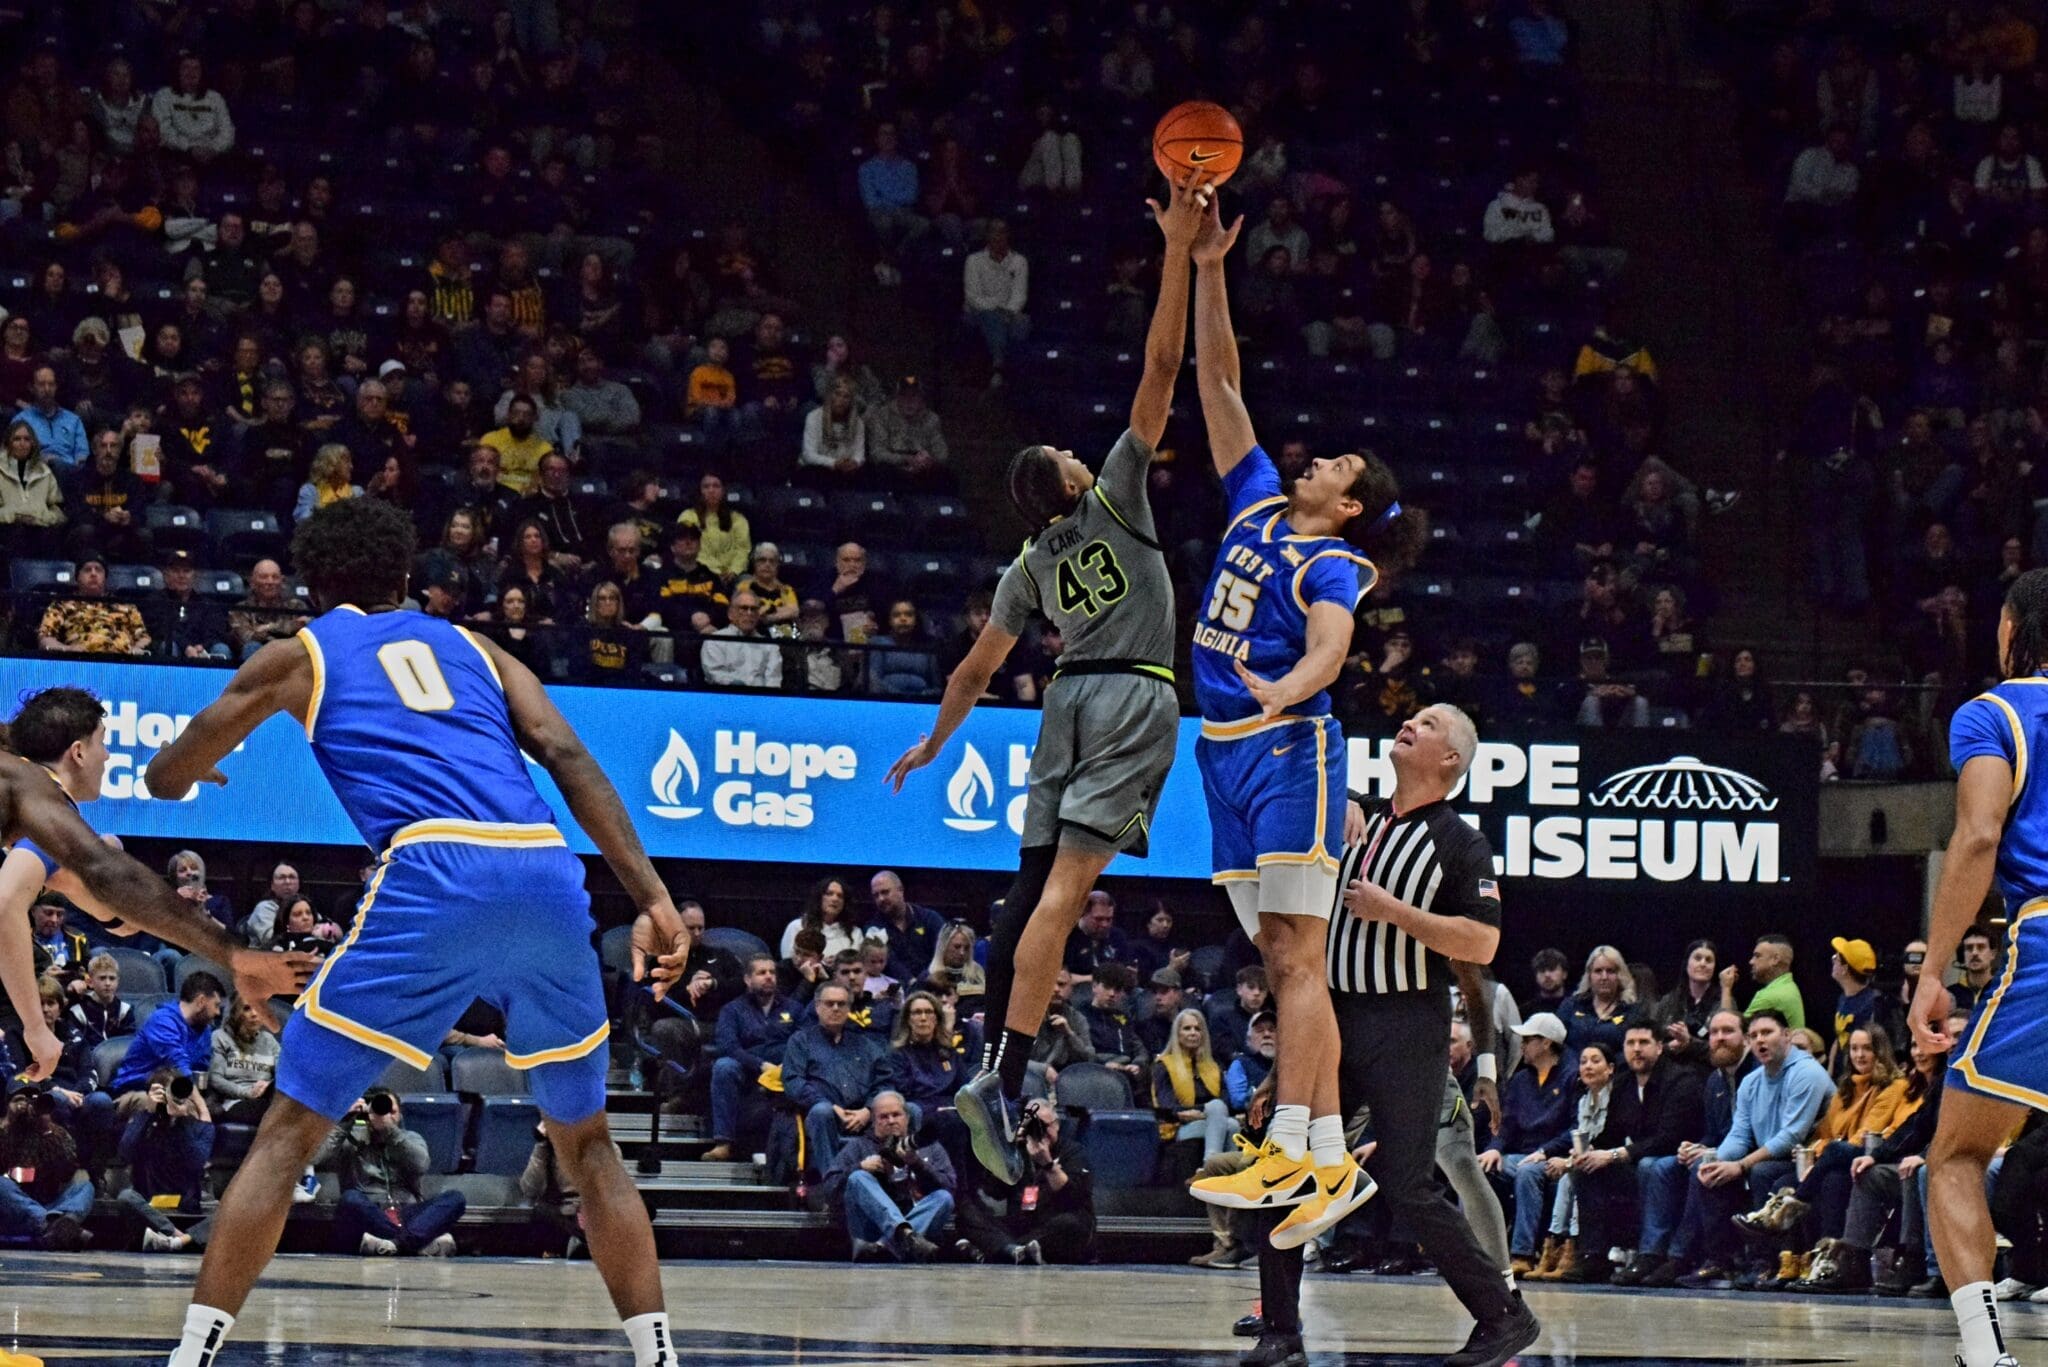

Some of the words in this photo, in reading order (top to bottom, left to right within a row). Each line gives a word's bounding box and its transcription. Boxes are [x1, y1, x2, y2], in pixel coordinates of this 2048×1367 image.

[1048, 525, 1084, 556] CARR
[1057, 541, 1128, 617] 43
[1207, 568, 1261, 632] 55
[376, 639, 456, 712] 0
[715, 729, 858, 789] Hope
[1347, 738, 1580, 806] HPE
[713, 780, 814, 827] Gas
[1458, 814, 1779, 883] ISEUM
